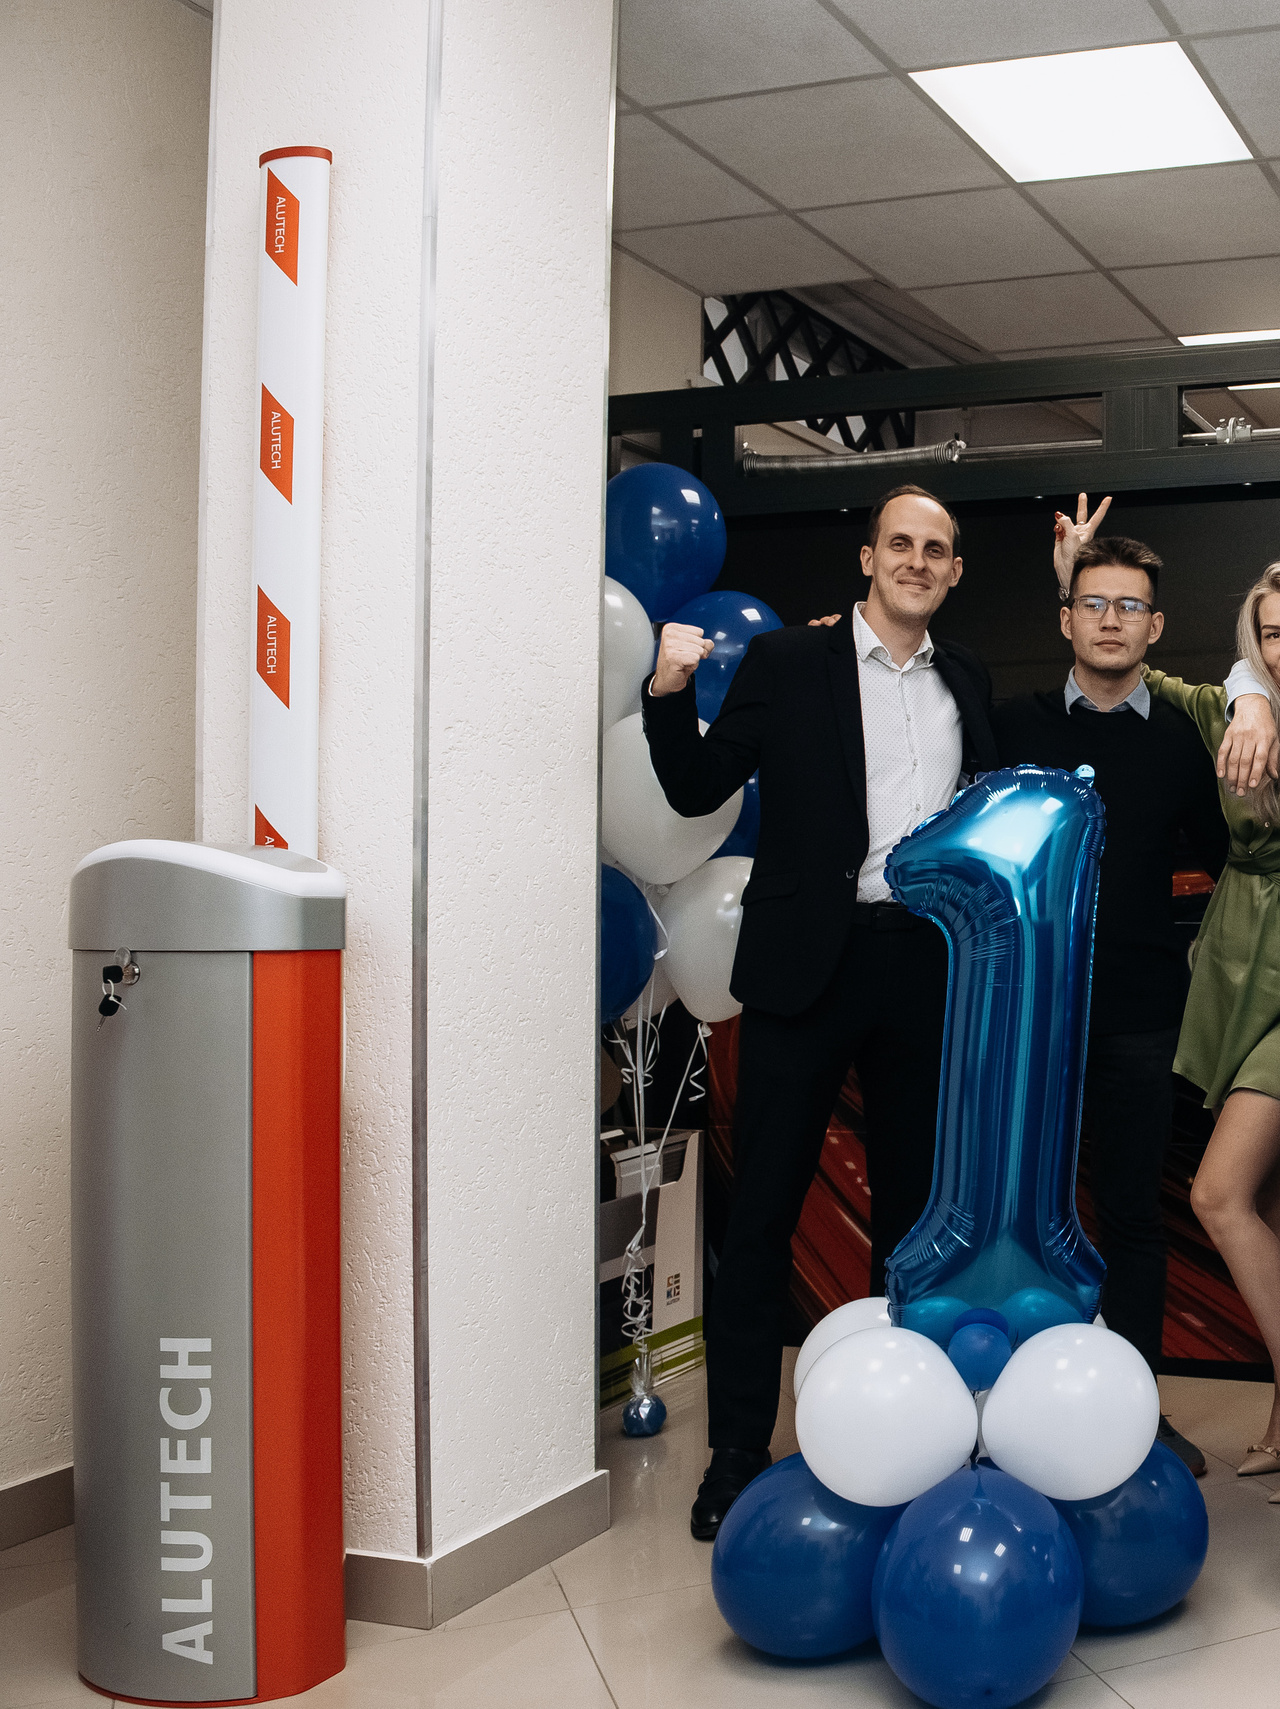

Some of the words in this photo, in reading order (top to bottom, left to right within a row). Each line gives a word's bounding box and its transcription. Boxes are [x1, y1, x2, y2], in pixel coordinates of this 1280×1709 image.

[275, 196, 286, 254] ALUTECH
[271, 411, 281, 470] ALUTECH
[266, 615, 277, 675] ALUTECH
[159, 1337, 214, 1665] ALUTECH
